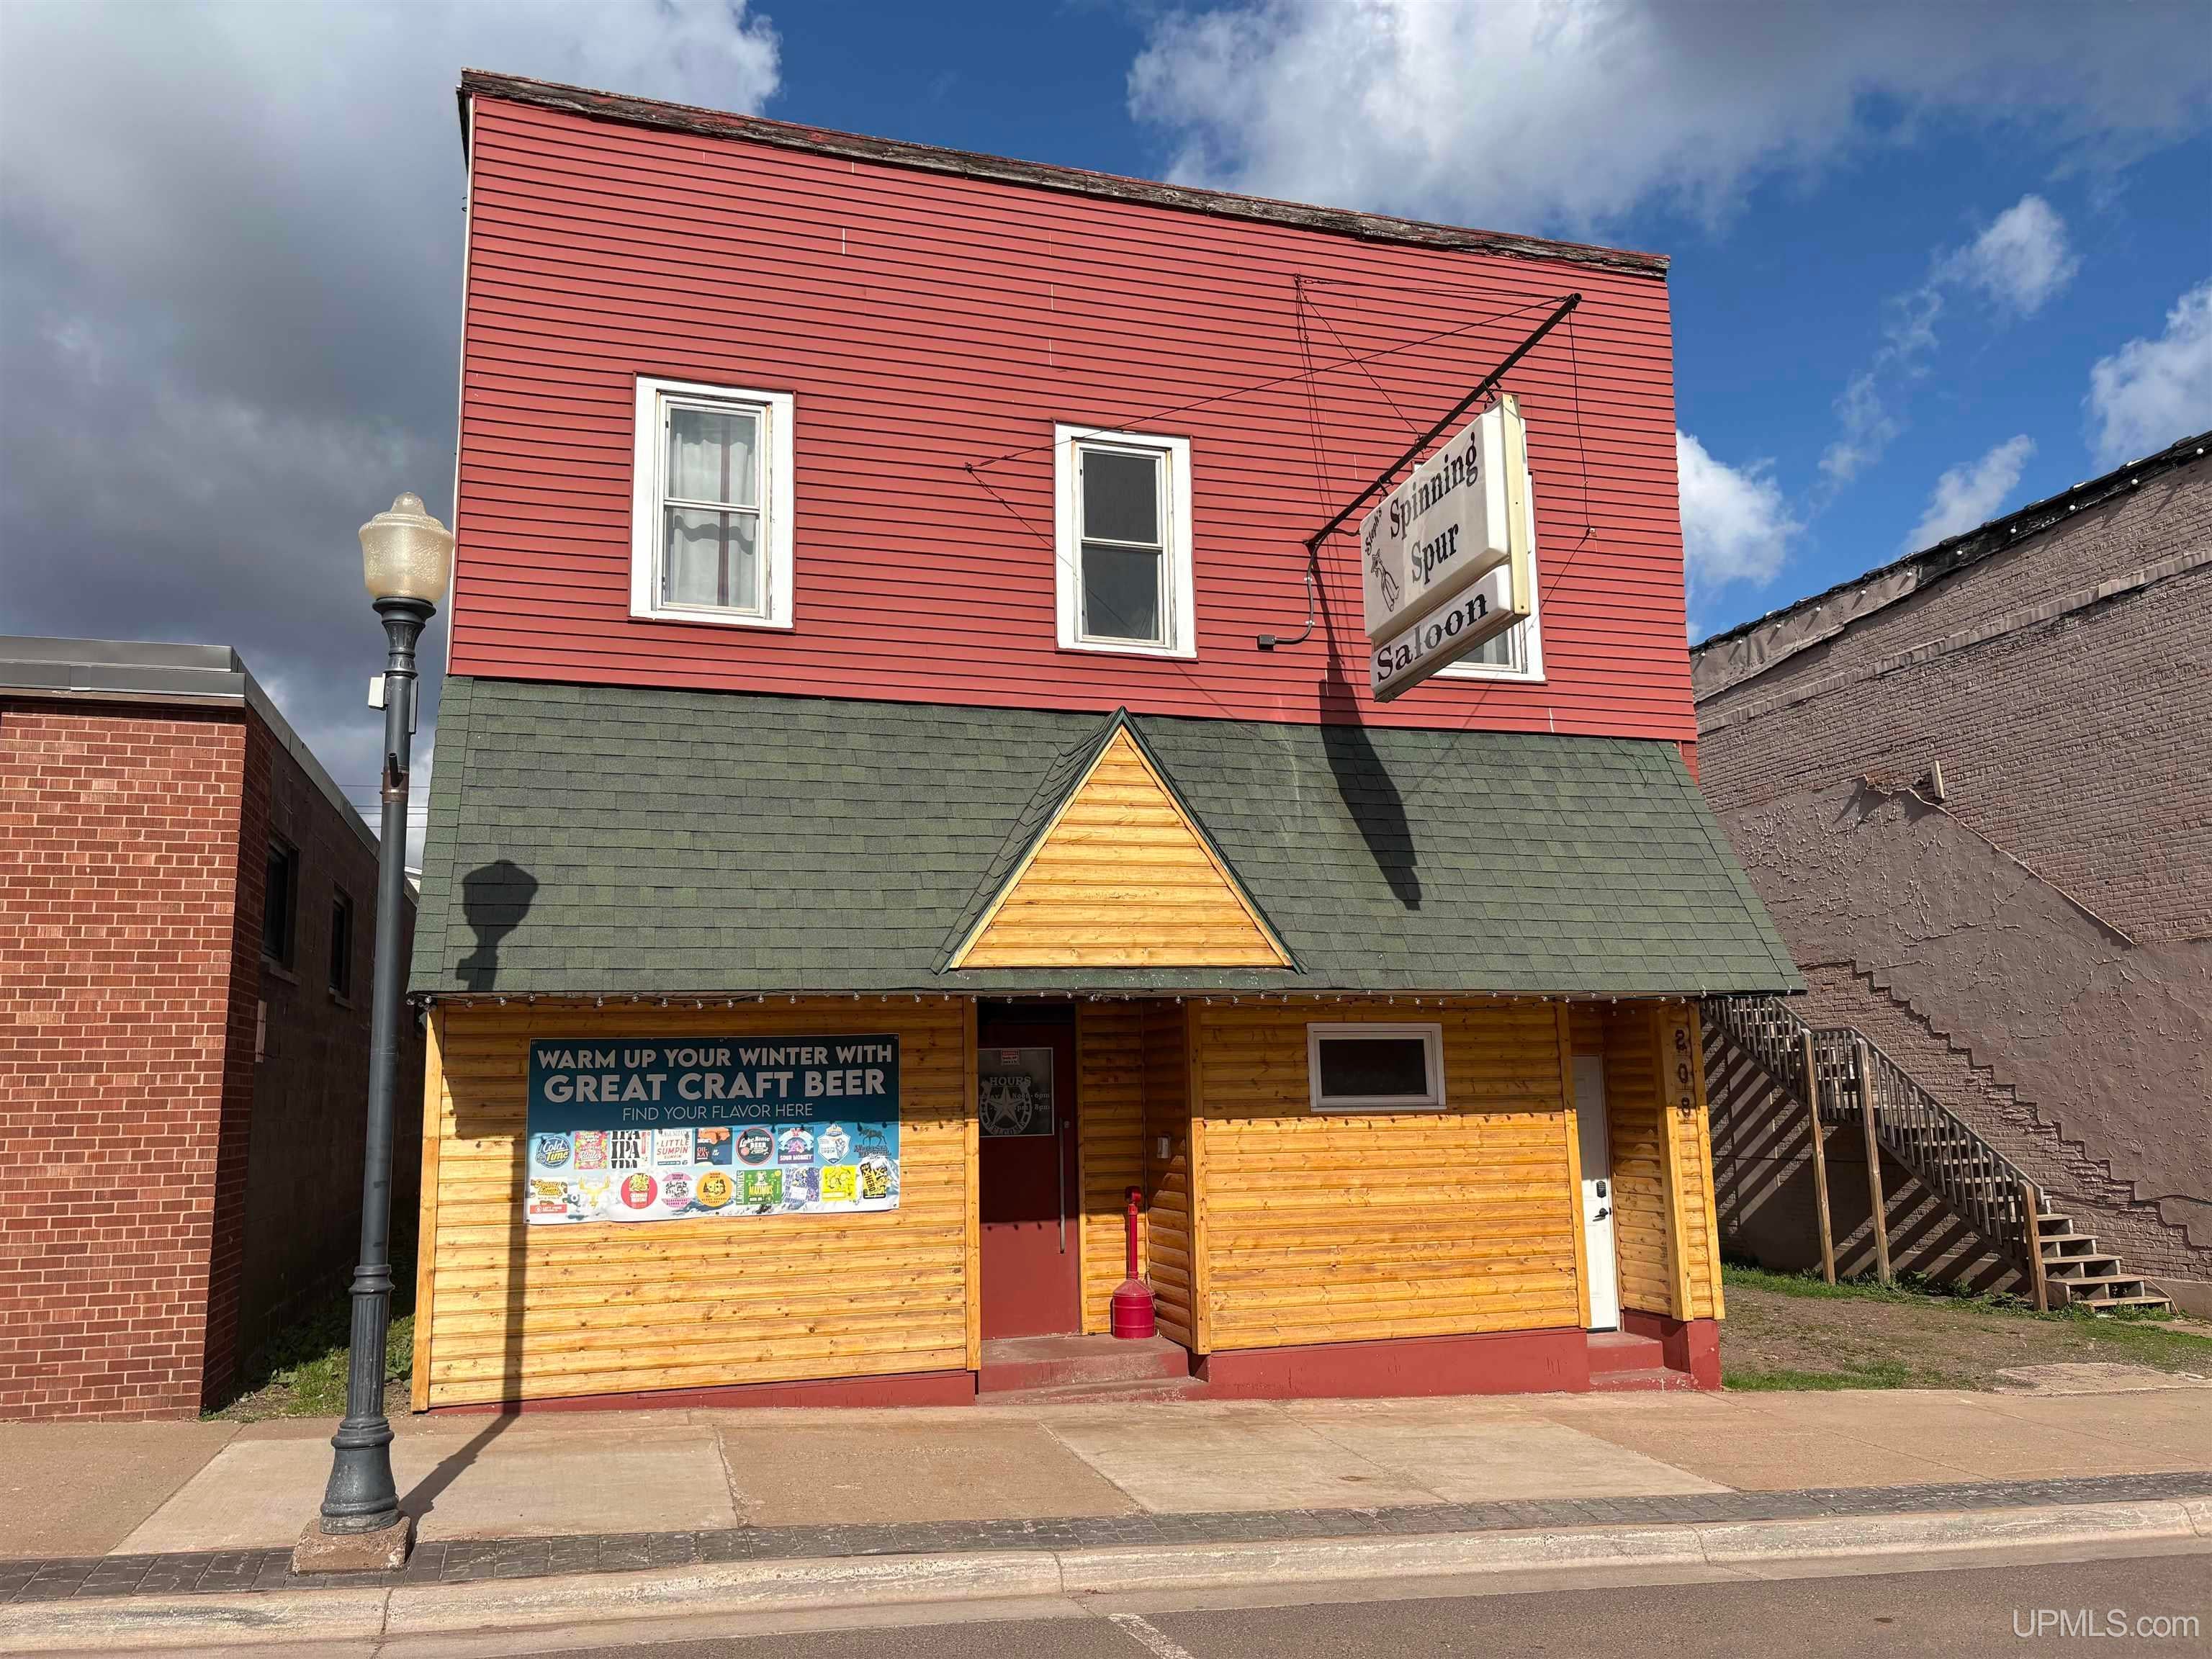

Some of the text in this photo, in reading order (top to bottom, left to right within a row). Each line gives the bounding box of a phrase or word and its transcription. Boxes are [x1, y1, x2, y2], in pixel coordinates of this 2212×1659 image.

[1390, 432, 1479, 540] Spinning
[1364, 505, 1383, 556] Steph's
[1411, 523, 1460, 585] Spur
[1377, 593, 1489, 683] Saloon
[537, 1044, 893, 1070] WARM UP YOUR WINTER WITH
[544, 1069, 886, 1103] GREAT CRAFT BEER
[622, 1103, 813, 1121] FIND YOUR FLAVOR HERE
[543, 1140, 565, 1152] Cold
[547, 1151, 569, 1161] Time
[611, 1141, 640, 1159] IPA
